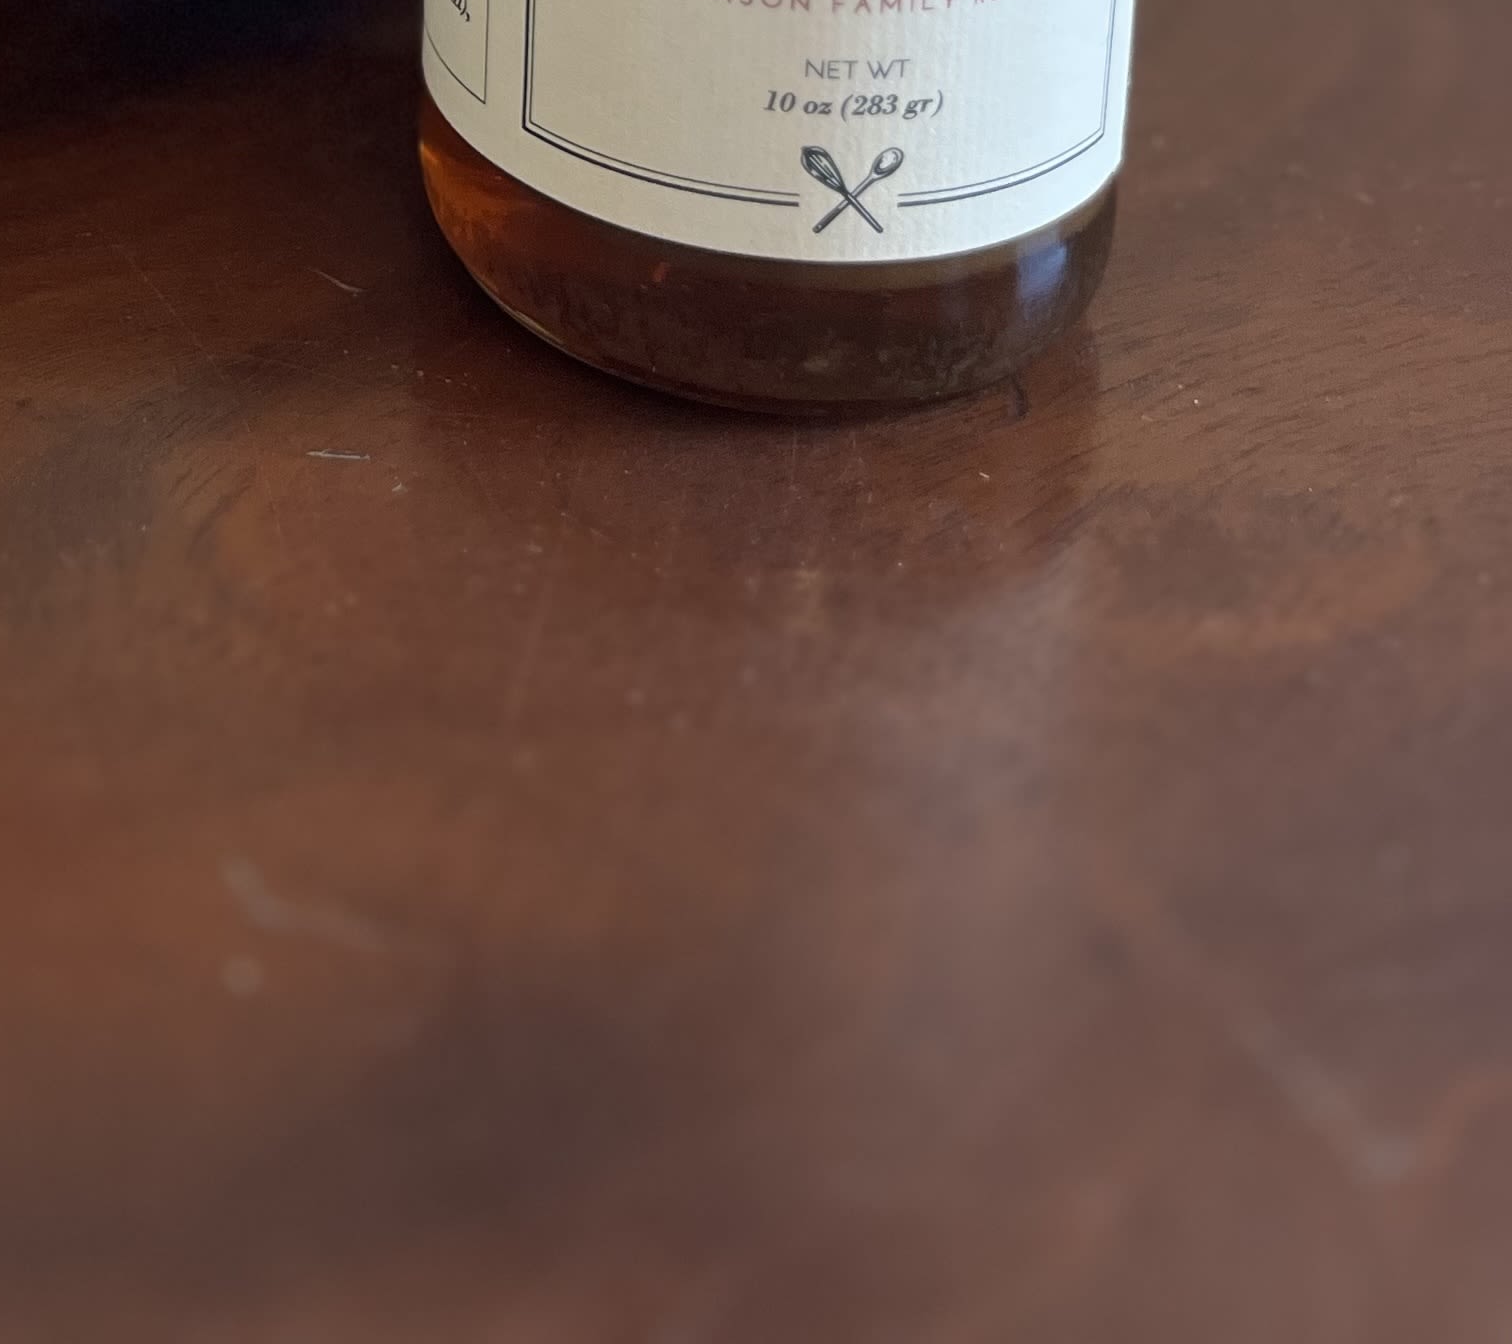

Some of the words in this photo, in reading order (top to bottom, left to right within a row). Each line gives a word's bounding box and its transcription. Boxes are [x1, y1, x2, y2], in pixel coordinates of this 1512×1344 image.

[804, 59, 858, 80] NET
[868, 59, 911, 80] WT
[763, 90, 797, 113] 10
[803, 100, 833, 115] oz
[840, 93, 898, 123] (283
[902, 90, 944, 121] gr)
